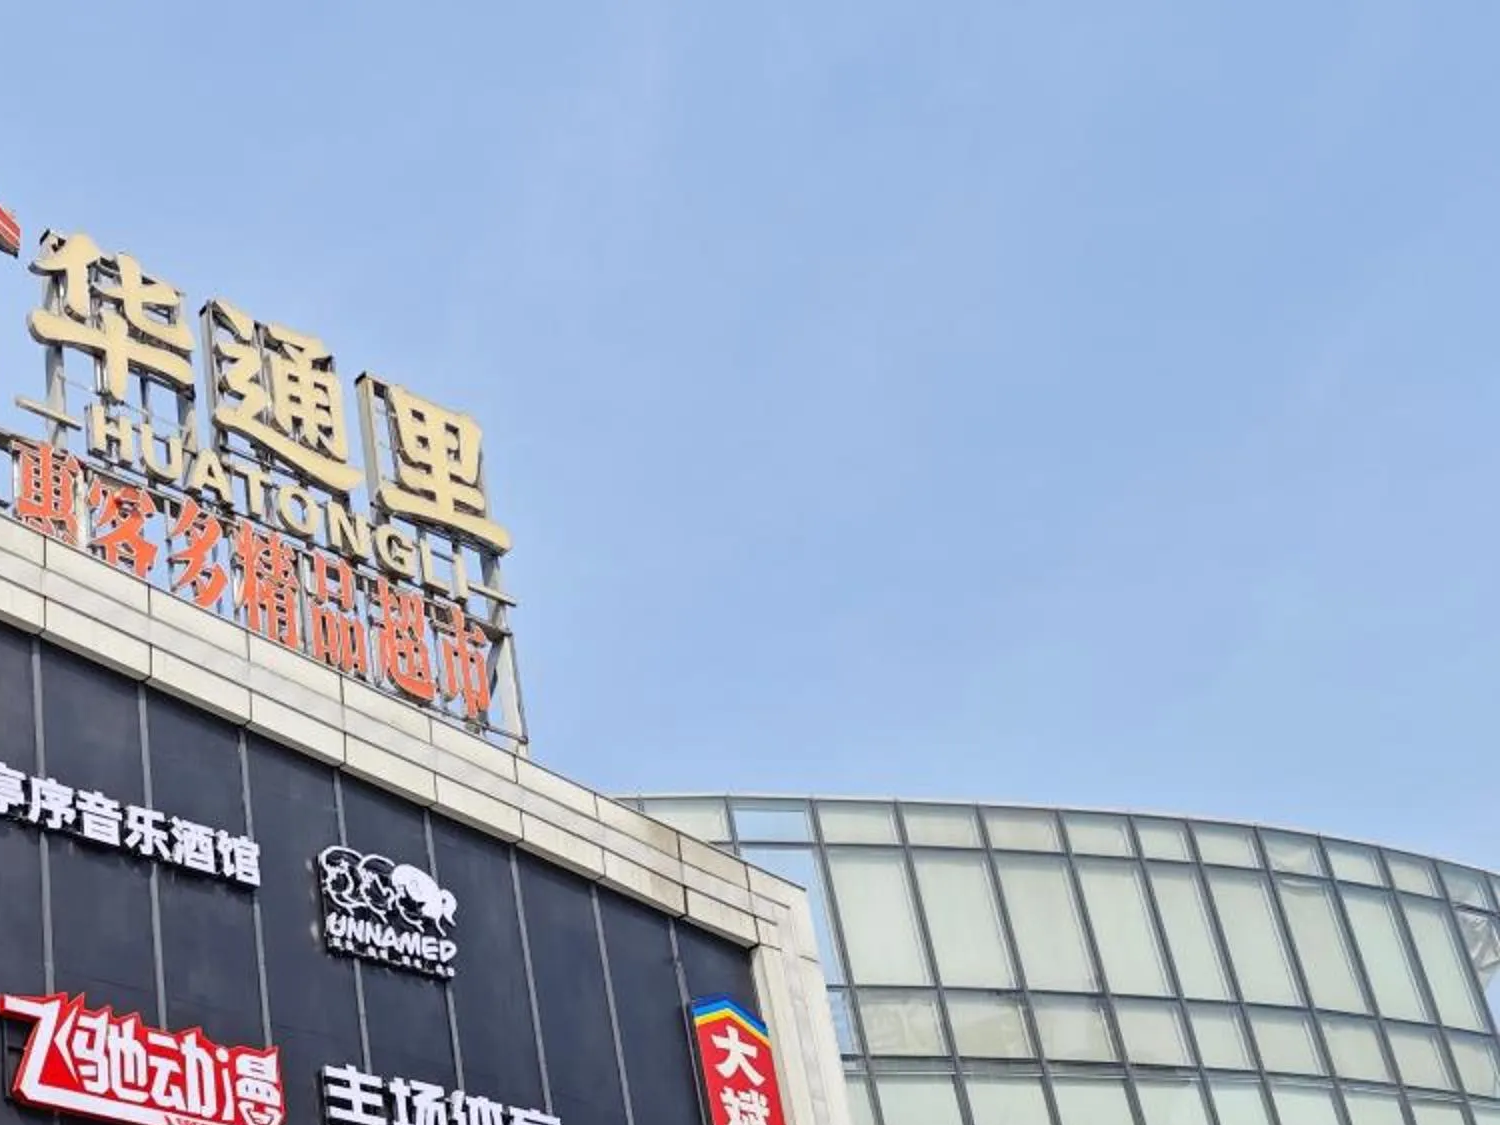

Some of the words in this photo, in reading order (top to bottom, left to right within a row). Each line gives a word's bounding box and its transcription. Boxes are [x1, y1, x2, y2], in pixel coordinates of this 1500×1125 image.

[27, 233, 511, 554] 华通里
[86, 404, 470, 600] HUATONGLI
[13, 440, 494, 717] 惠客多精品超市
[326, 912, 458, 963] UNNAMED
